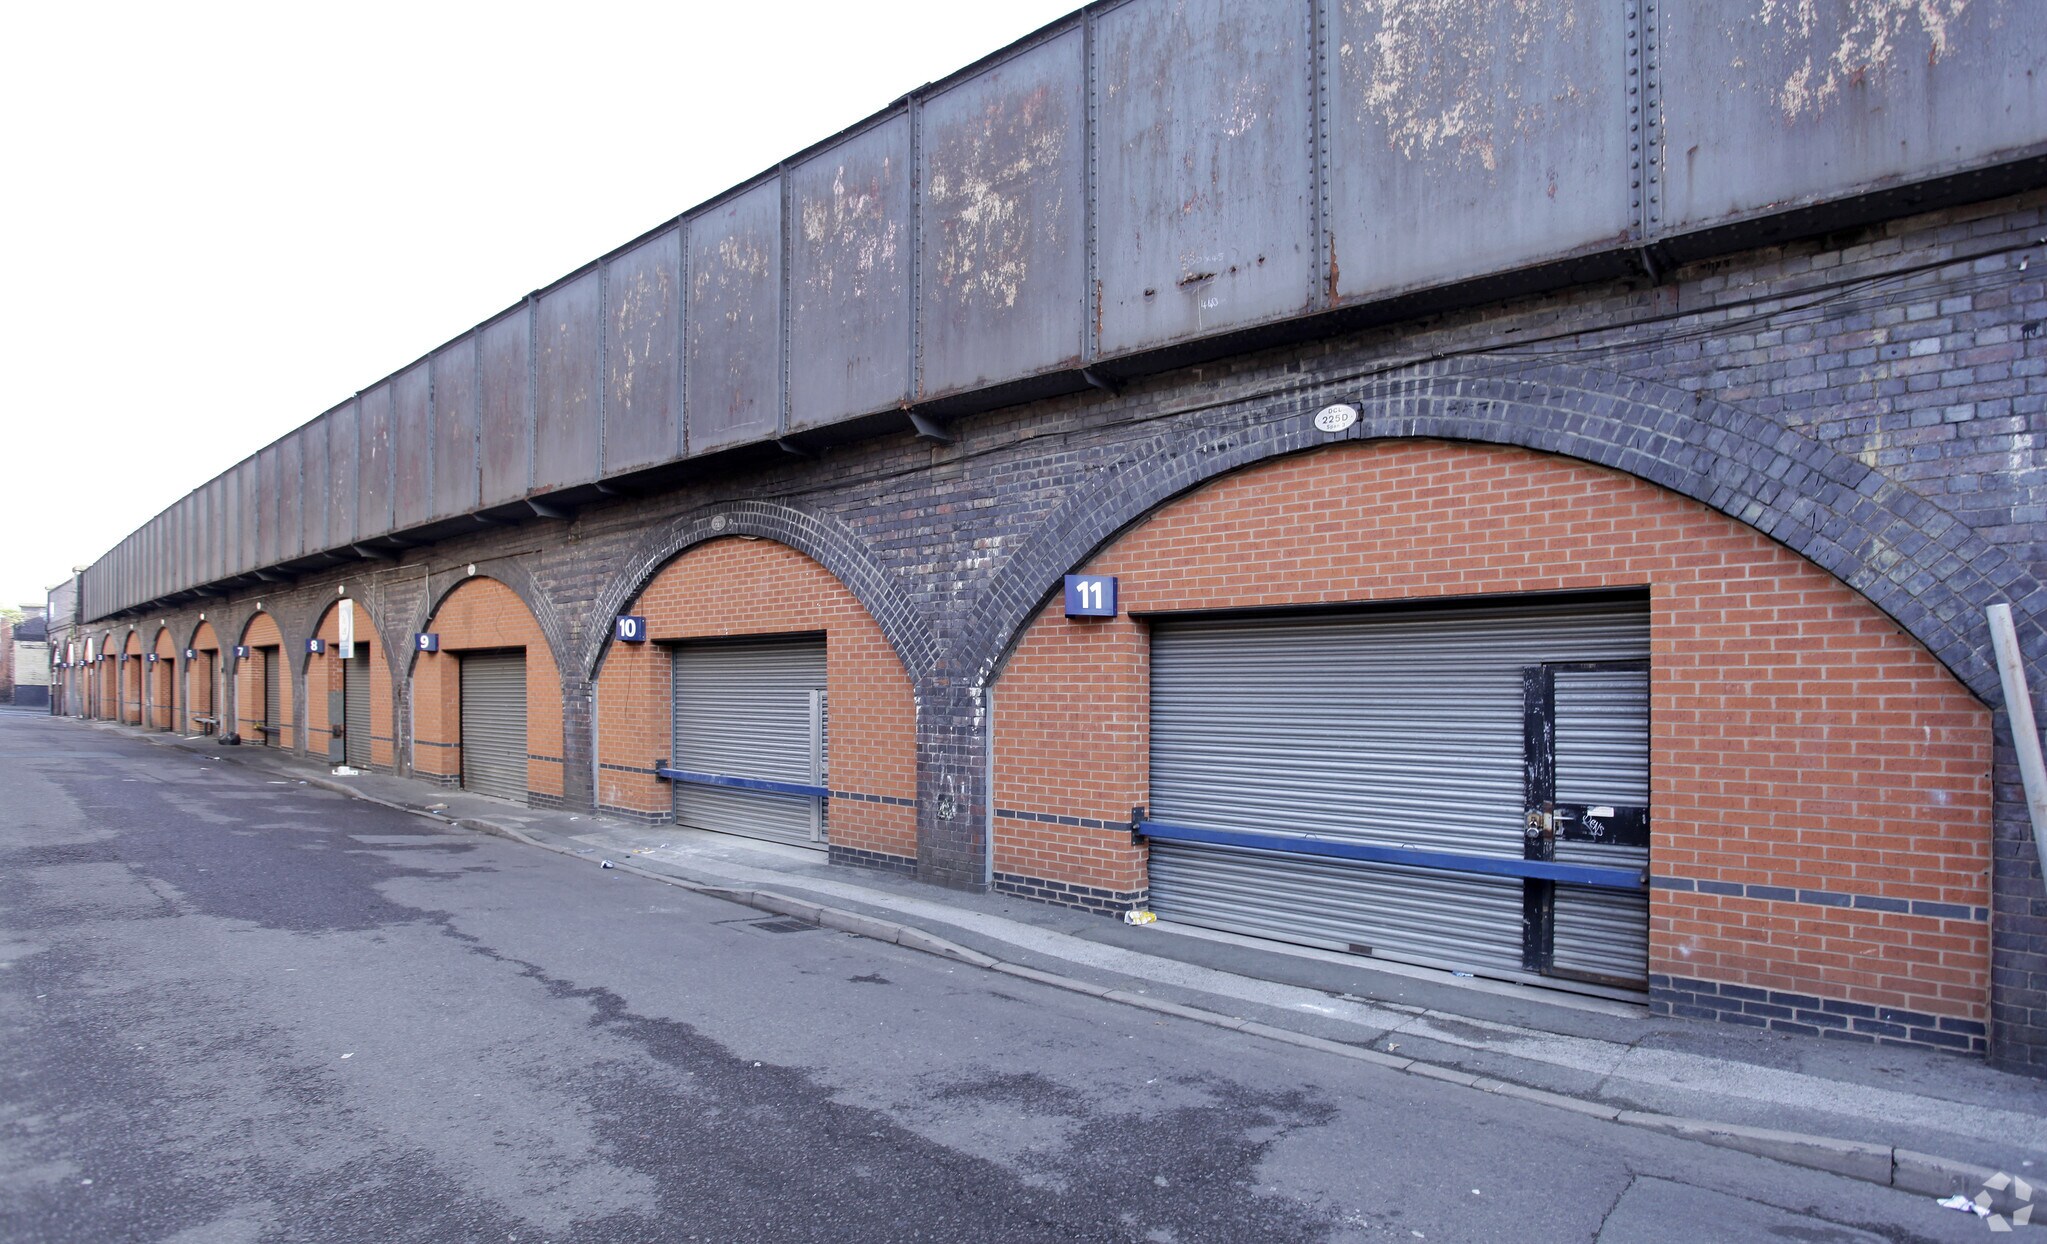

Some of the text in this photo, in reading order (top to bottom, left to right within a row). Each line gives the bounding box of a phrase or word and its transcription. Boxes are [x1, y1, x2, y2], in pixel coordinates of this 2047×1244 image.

[1201, 298, 1219, 310] 440
[1322, 413, 1348, 425] 225D
[1076, 581, 1102, 609] 11
[619, 618, 636, 637] 10
[310, 640, 318, 651] 8
[420, 635, 429, 649] 9
[186, 650, 192, 658] 6
[237, 647, 244, 656] 7
